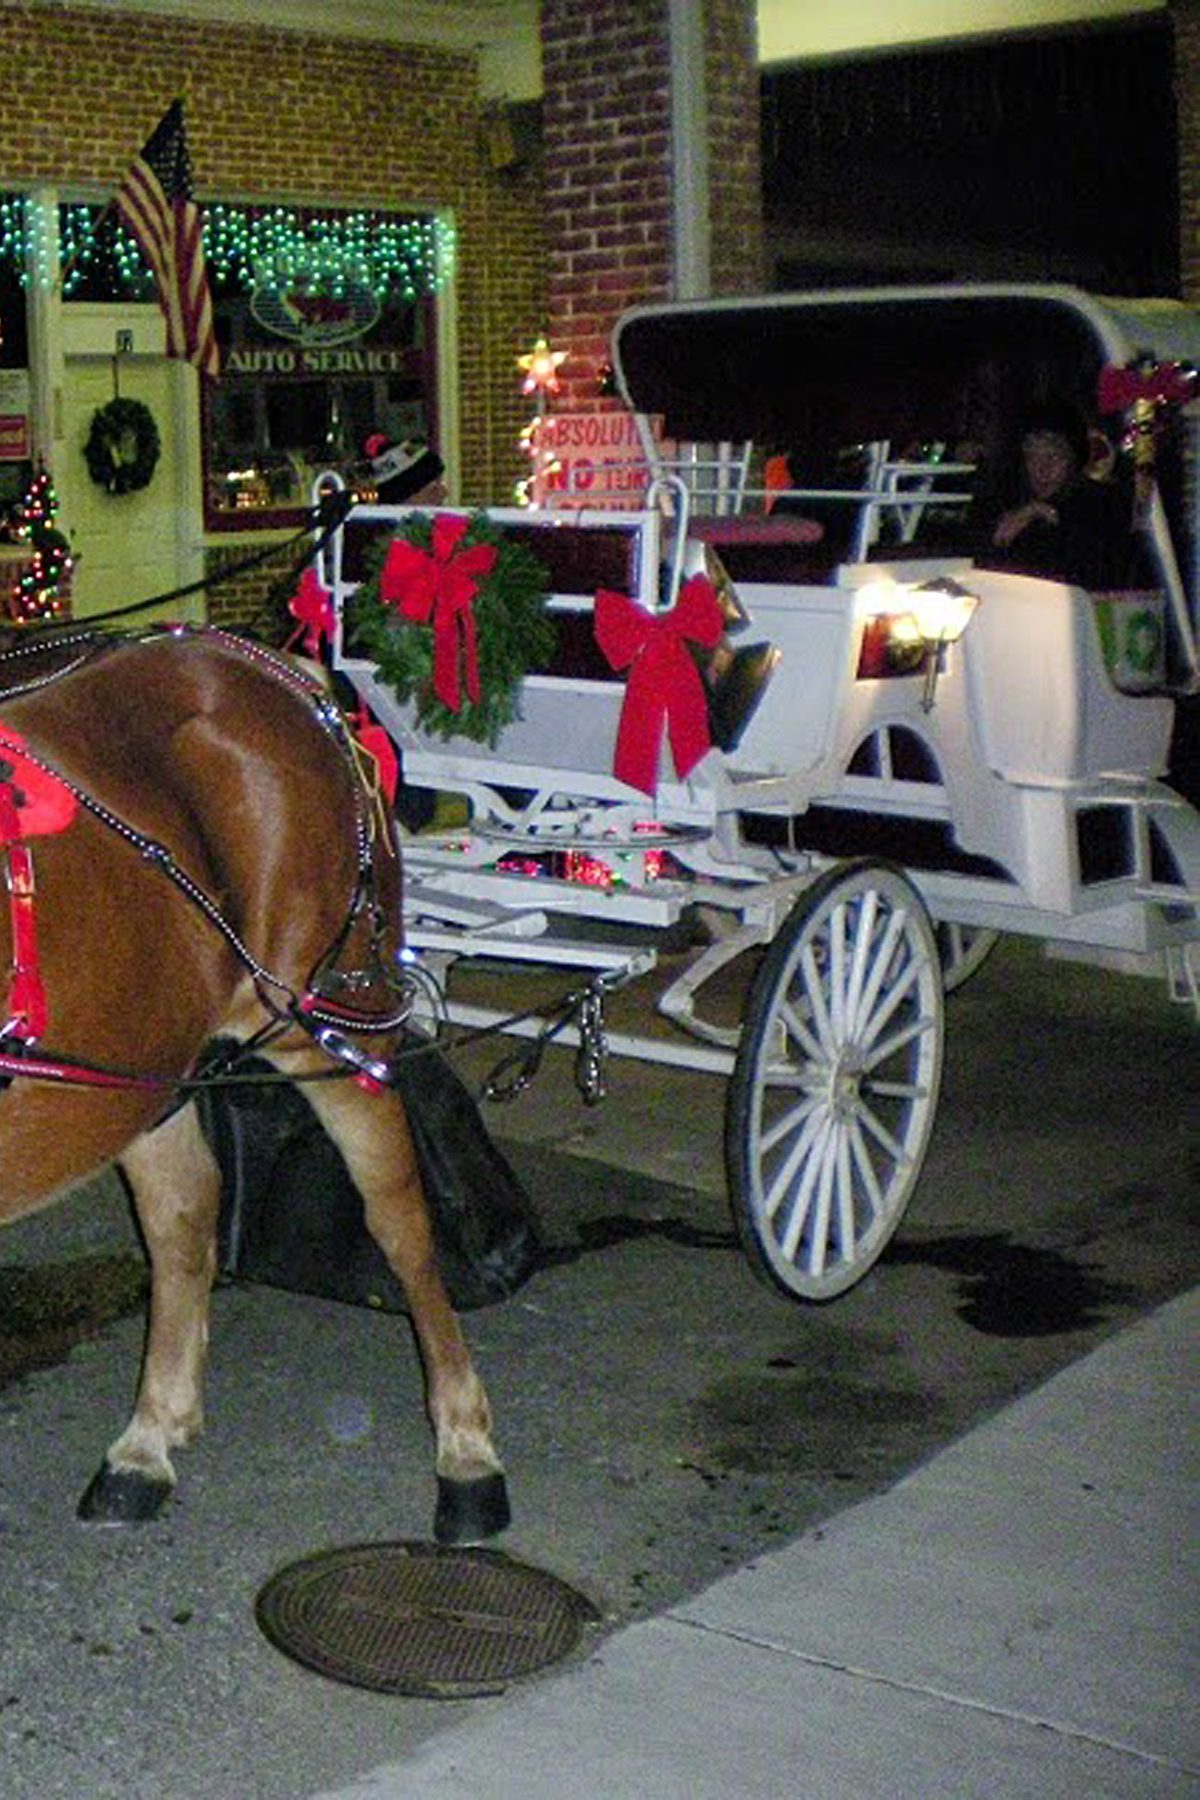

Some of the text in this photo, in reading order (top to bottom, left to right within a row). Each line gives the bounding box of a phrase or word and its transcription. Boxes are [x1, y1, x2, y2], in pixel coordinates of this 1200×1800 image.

[226, 350, 402, 372] AUTO SERVICE
[546, 457, 648, 490] NO TUR
